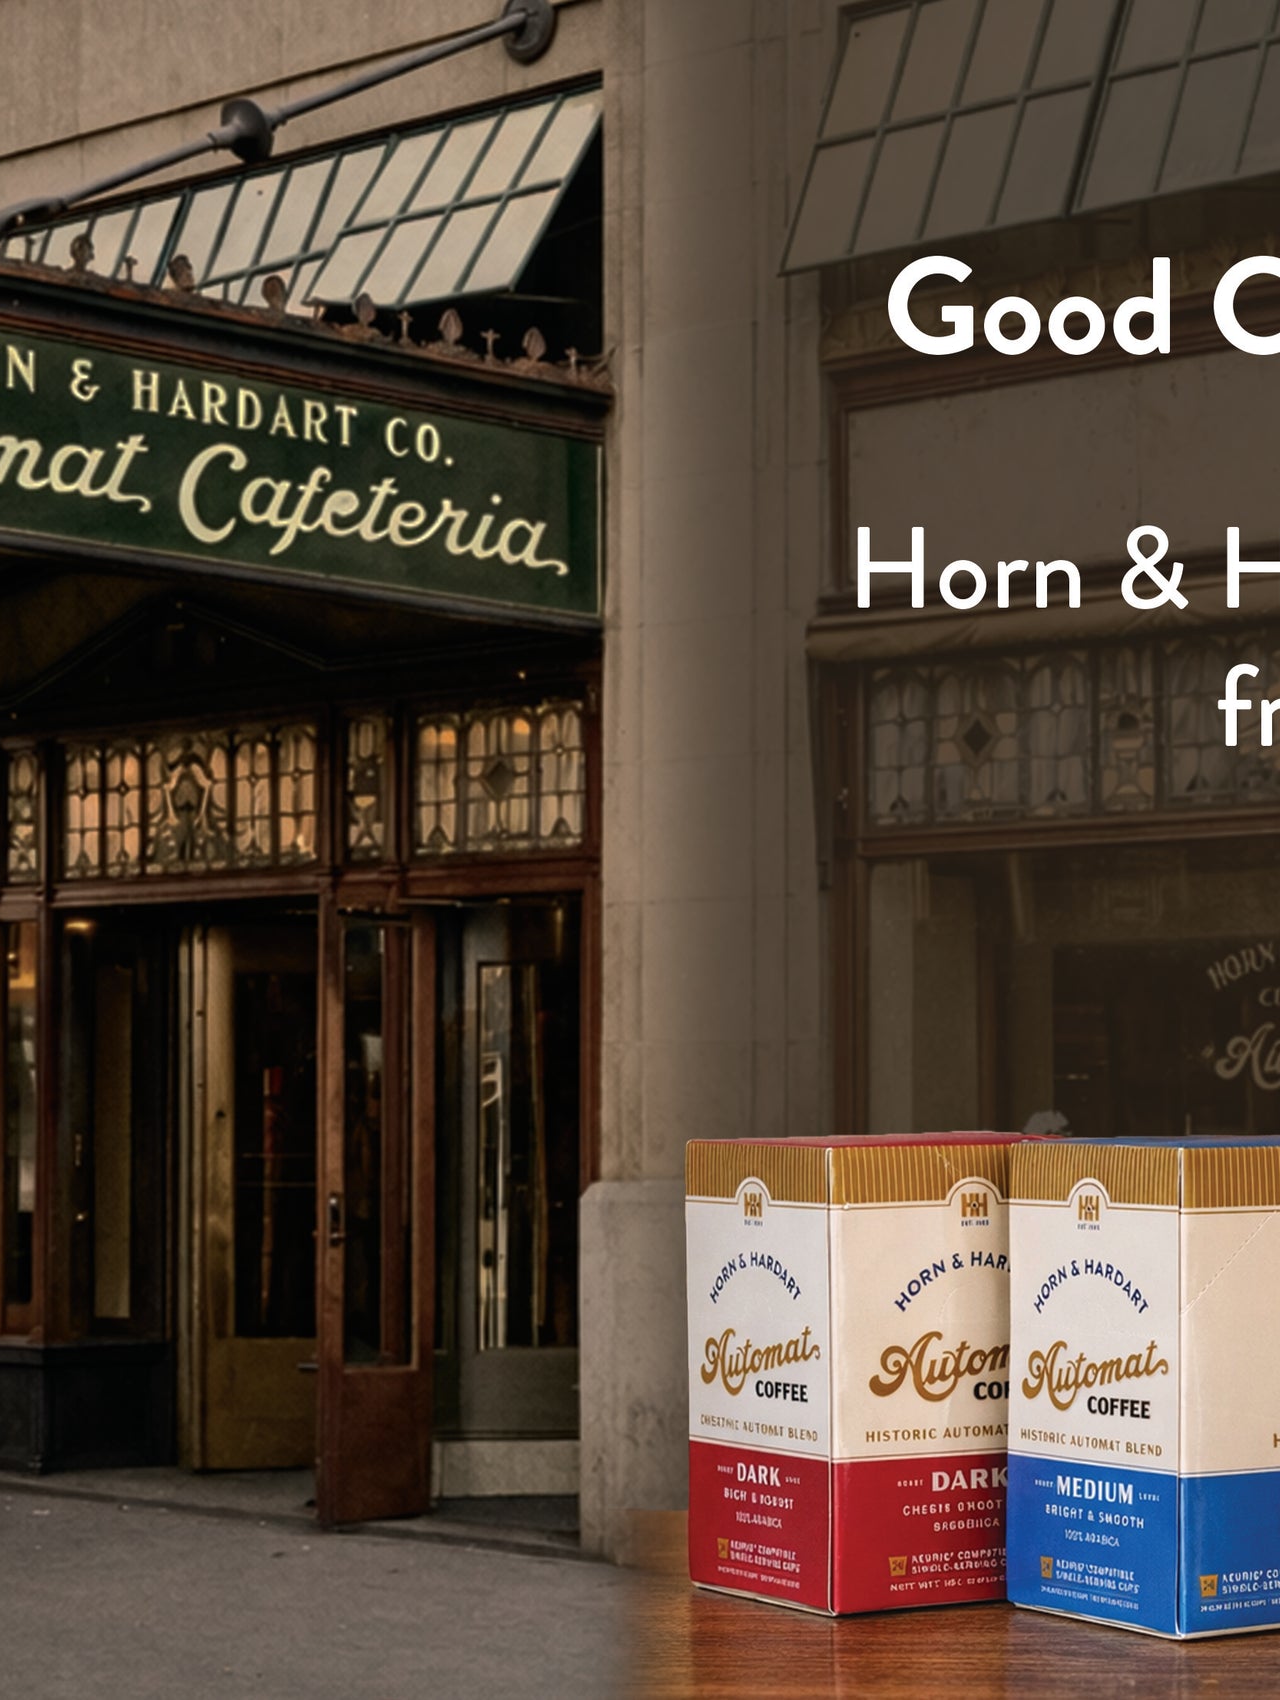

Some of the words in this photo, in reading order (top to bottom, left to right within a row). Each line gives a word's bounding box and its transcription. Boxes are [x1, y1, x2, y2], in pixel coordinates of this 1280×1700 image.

[70, 359, 99, 401] &
[132, 369, 357, 446] HARDART
[386, 417, 454, 466] CO.
[178, 443, 568, 576] Cafeteria
[710, 1259, 736, 1303] HORN
[739, 1253, 746, 1269] &
[751, 1252, 801, 1300] HARDART
[894, 1259, 946, 1312] HORN
[952, 1253, 964, 1269] &
[971, 1252, 1010, 1273] HAR
[1033, 1266, 1067, 1314] HORN
[1071, 1260, 1080, 1276] &
[1085, 1259, 1148, 1314] HARDART
[701, 1326, 820, 1396] Automat
[1022, 1340, 1168, 1411] Automat
[756, 1380, 808, 1403] COFFEE
[1087, 1396, 1150, 1419] COFFEE
[866, 1428, 937, 1442] HISTORIC
[943, 1424, 1008, 1438] AUTOMAT
[1021, 1429, 1066, 1445] HISTORIC
[1126, 1442, 1162, 1456] BLEND
[737, 1462, 780, 1486] DARK
[932, 1467, 1007, 1491] DARK
[1057, 1475, 1133, 1505] MEDIUM
